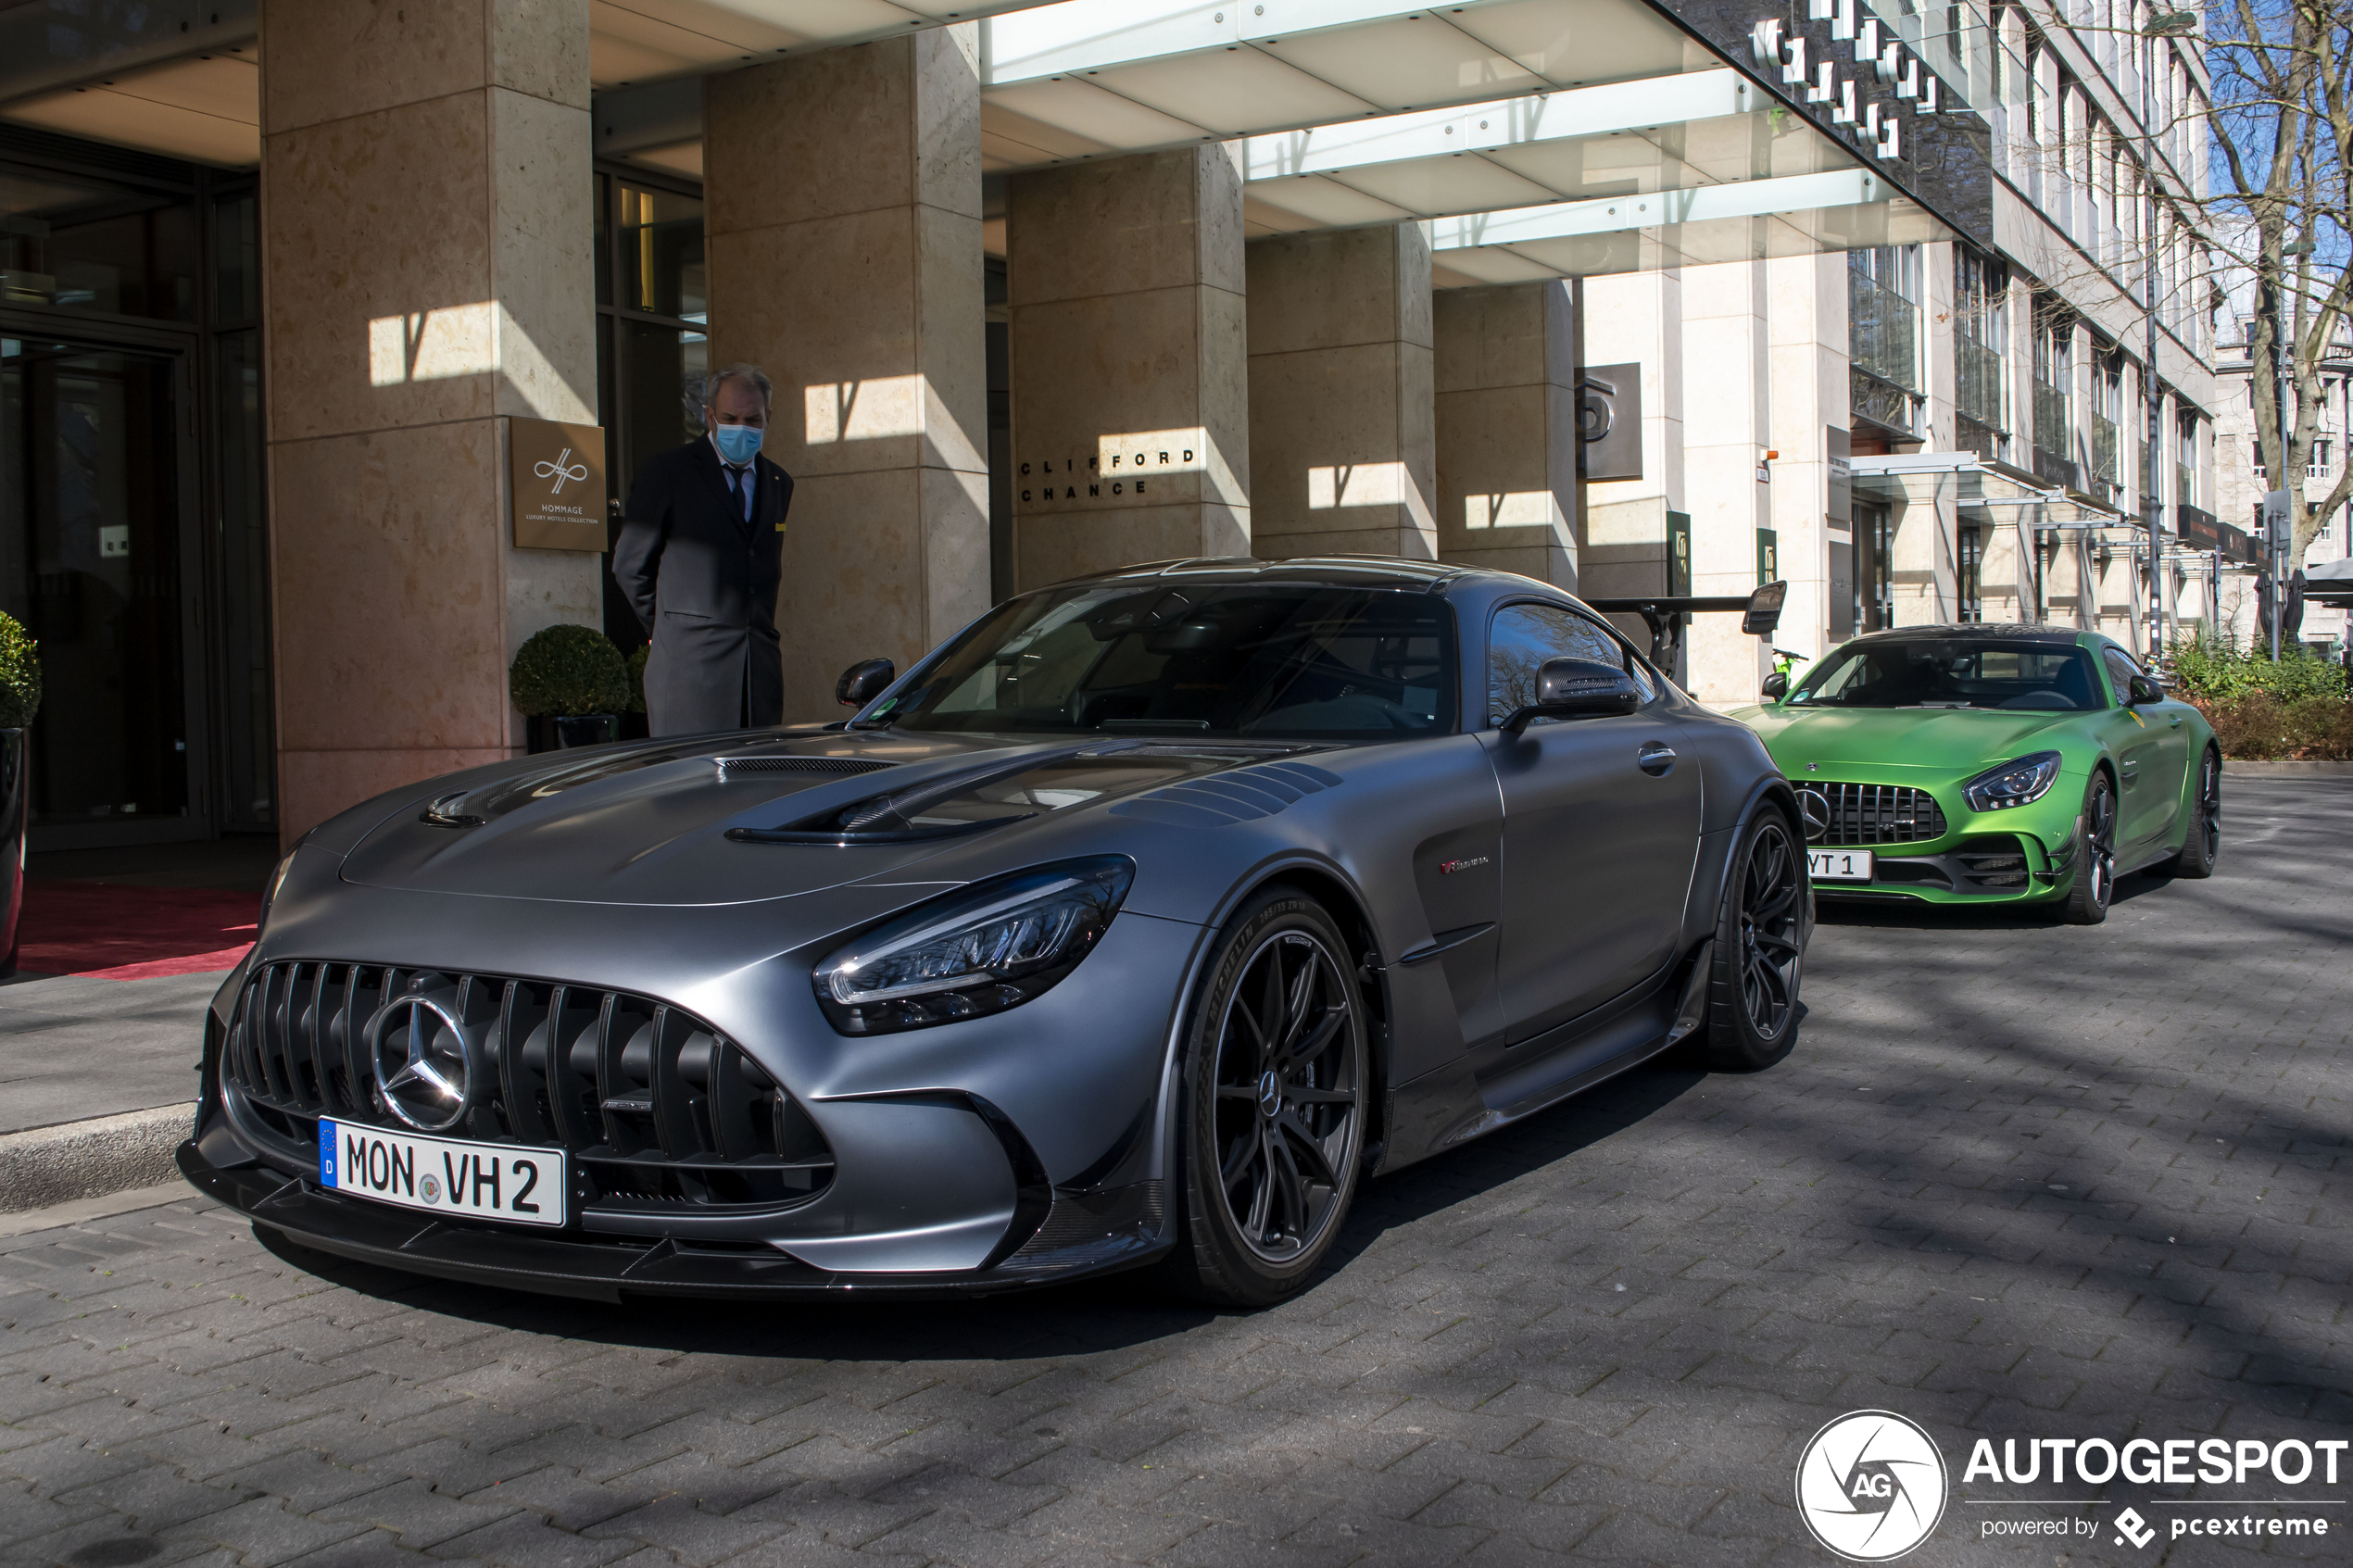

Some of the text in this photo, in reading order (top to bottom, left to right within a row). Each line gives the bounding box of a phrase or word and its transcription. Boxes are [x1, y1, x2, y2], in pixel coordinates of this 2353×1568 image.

[1021, 449, 1194, 475] CLIFFORD
[1021, 481, 1146, 502] CHANCE
[541, 504, 583, 515] HOMMAGE
[1842, 855, 1855, 875] 1
[1259, 901, 1306, 924] 285/35 ZR 19
[1209, 924, 1253, 1024] MICHELIN
[325, 1160, 333, 1174] D
[347, 1133, 414, 1198] MON
